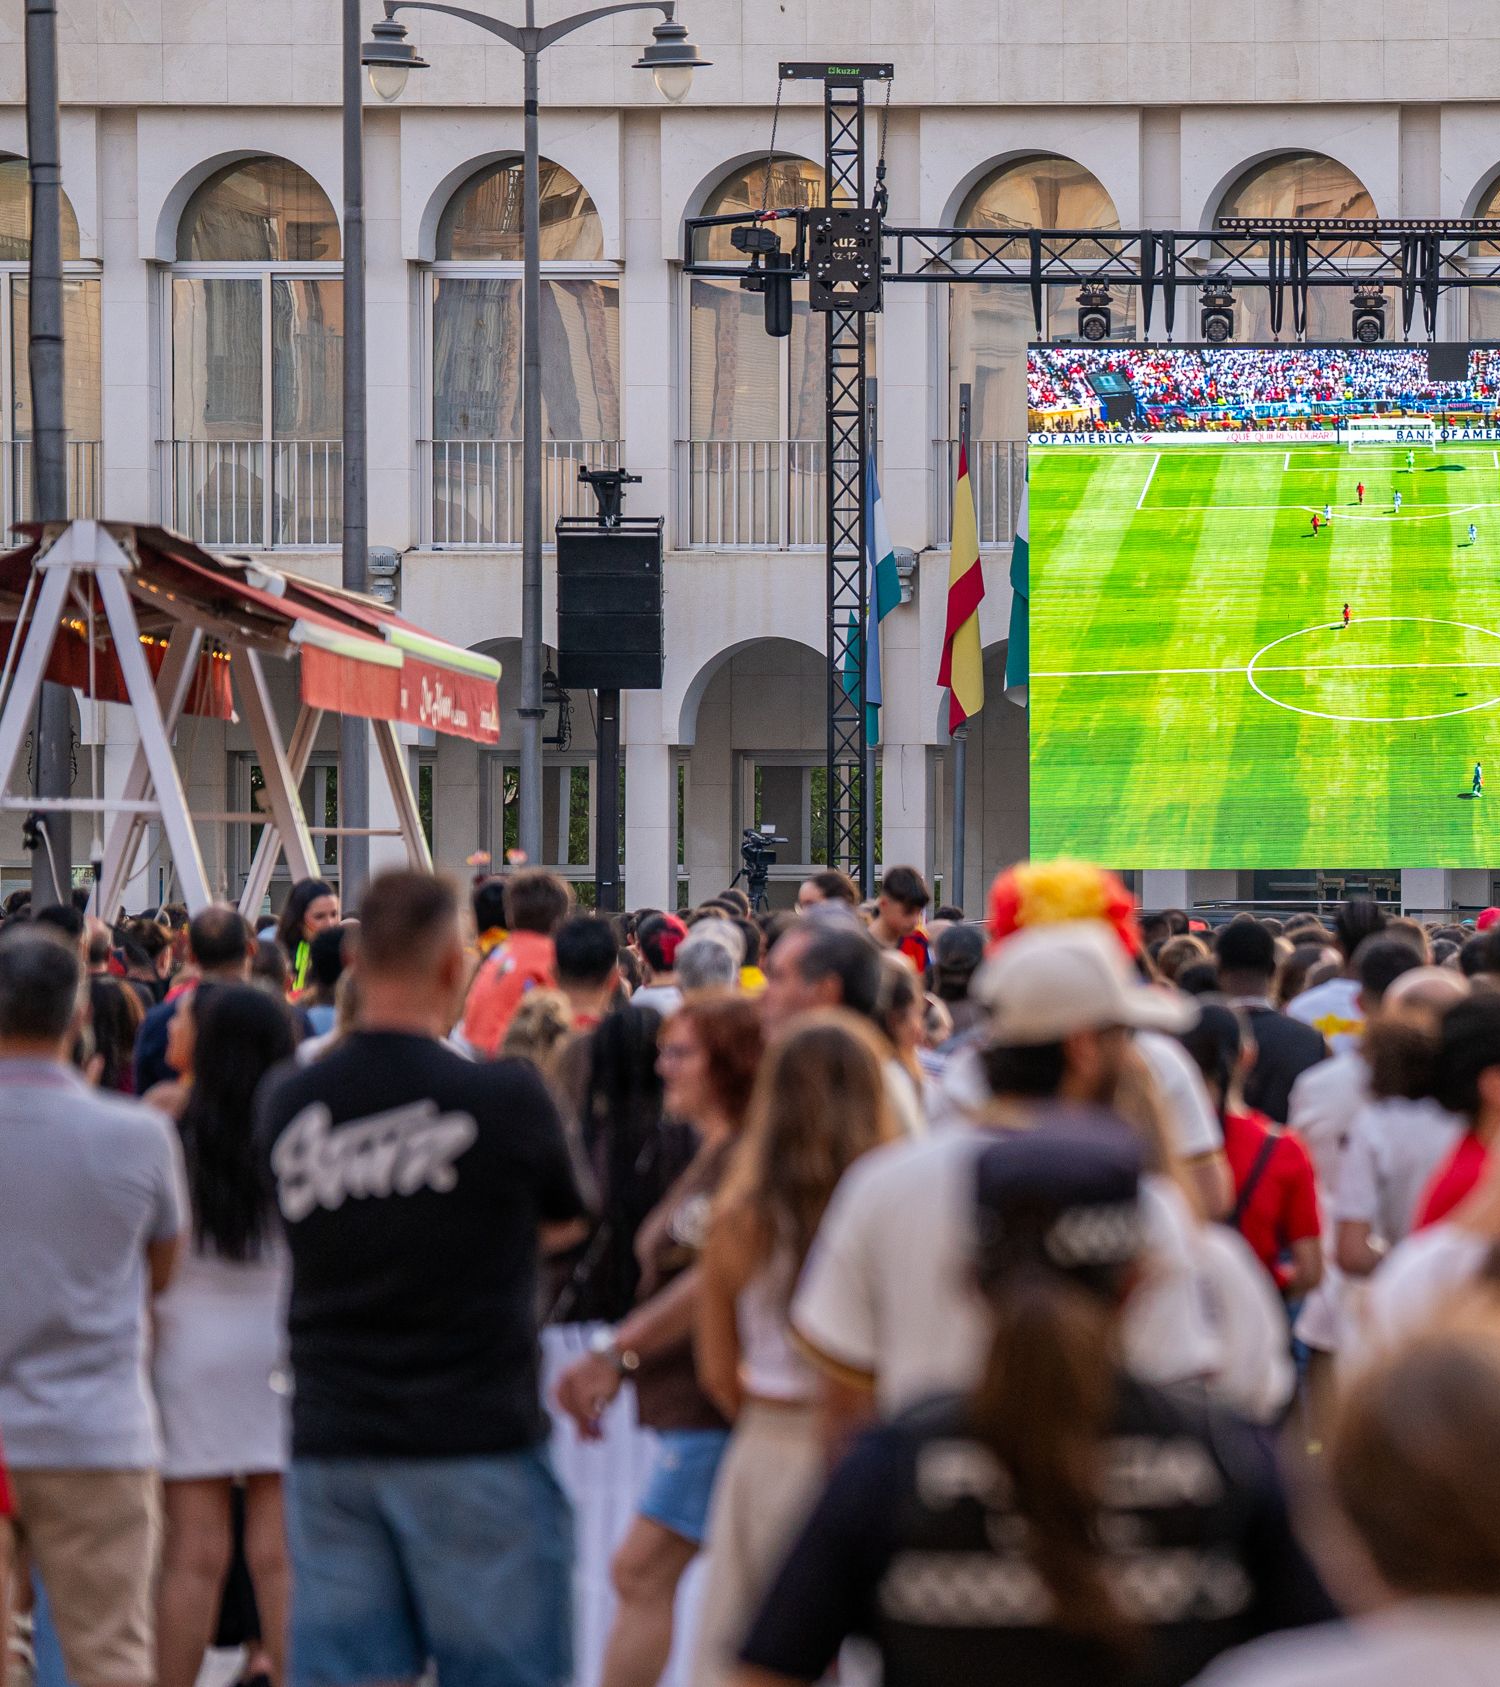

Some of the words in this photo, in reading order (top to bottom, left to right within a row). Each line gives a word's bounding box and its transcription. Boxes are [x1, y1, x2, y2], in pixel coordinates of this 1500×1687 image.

[836, 66, 860, 75] kuzar
[1038, 434, 1057, 443] OF
[1063, 433, 1134, 443] AMERICA
[1396, 430, 1434, 440] BANK
[1441, 429, 1458, 439] OF
